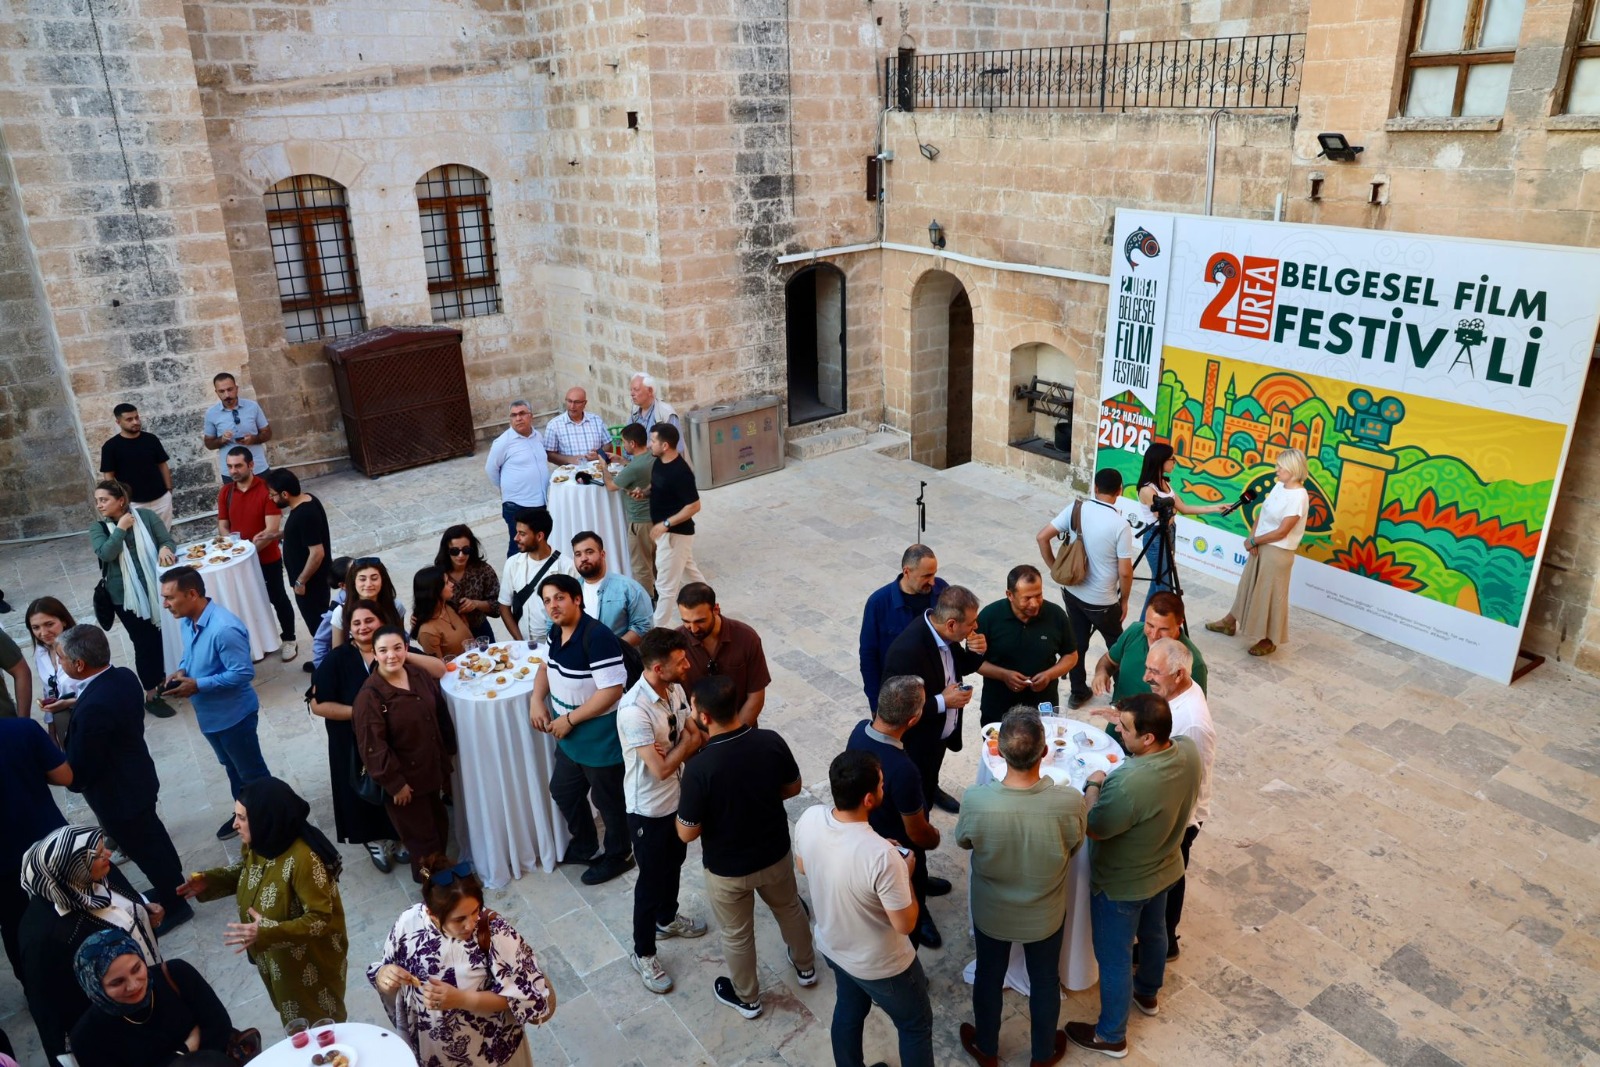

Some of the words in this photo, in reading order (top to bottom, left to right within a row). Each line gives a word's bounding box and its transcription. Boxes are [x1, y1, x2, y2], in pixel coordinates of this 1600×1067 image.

[1118, 295, 1156, 325] BELGESEL
[1238, 265, 1277, 335] URFA
[1281, 261, 1438, 307] BELGESEL
[1453, 274, 1547, 322] FİLM
[1101, 405, 1121, 420] 18-22
[1098, 418, 1151, 456] 2026
